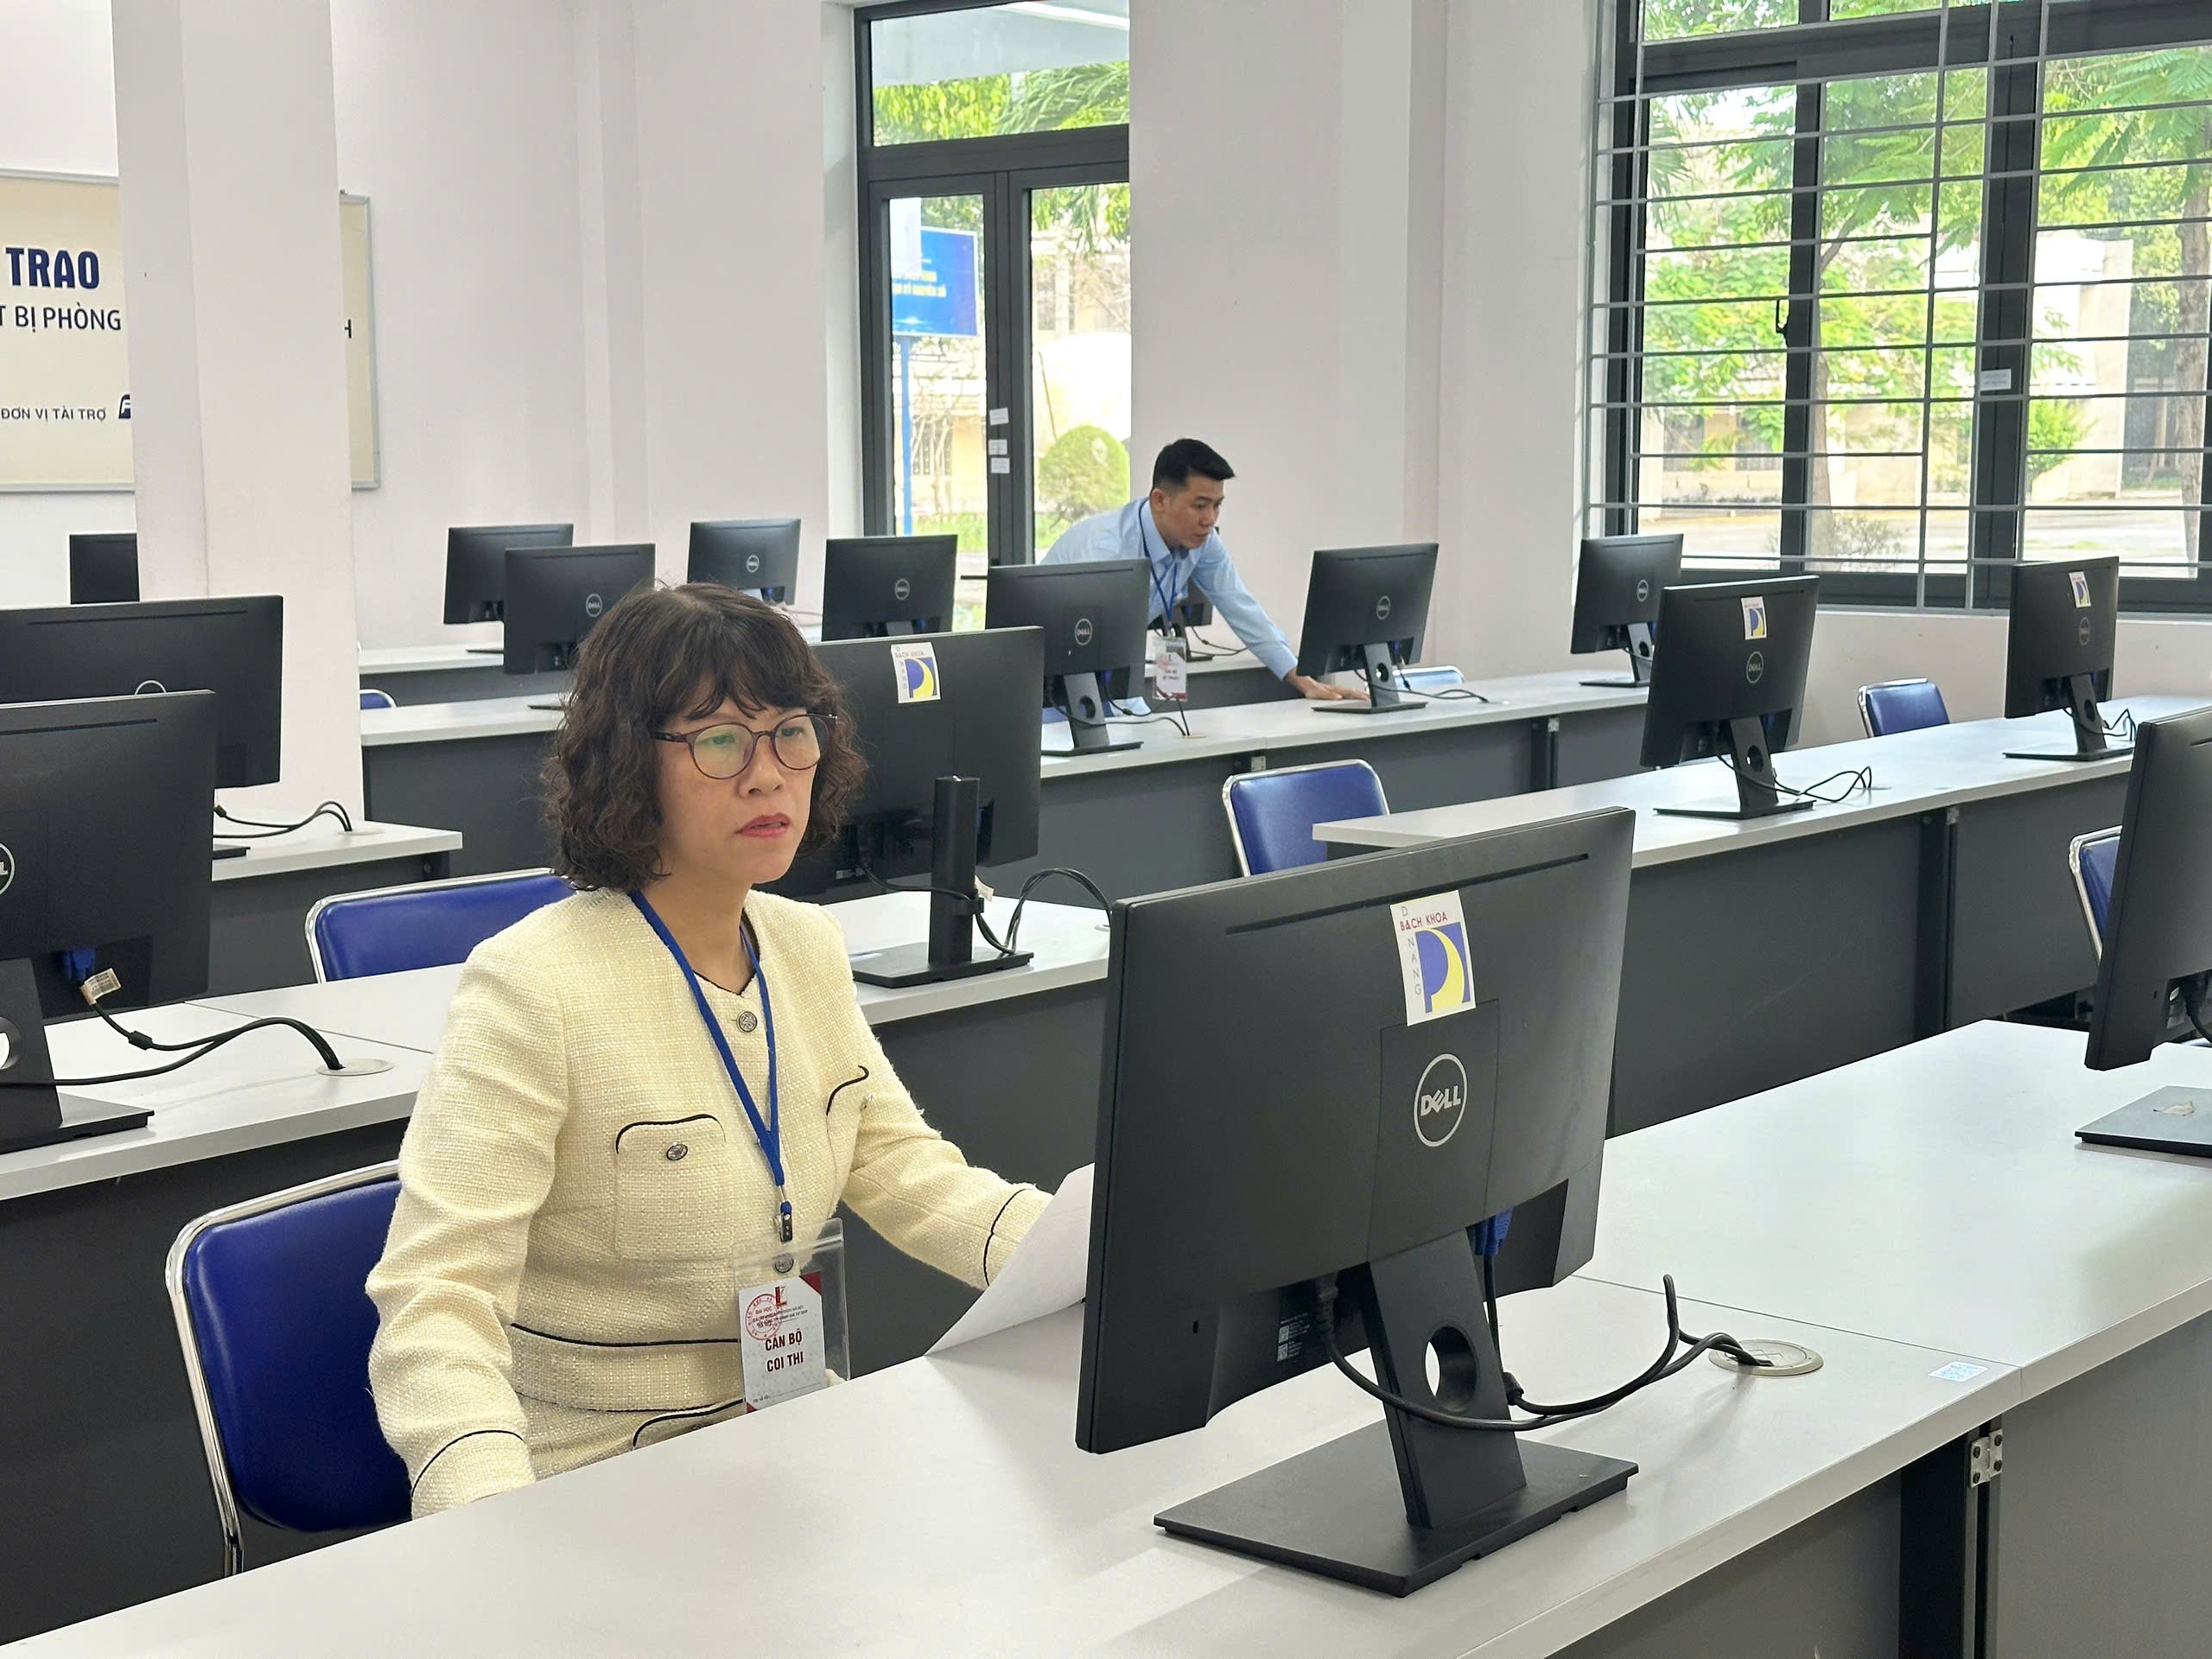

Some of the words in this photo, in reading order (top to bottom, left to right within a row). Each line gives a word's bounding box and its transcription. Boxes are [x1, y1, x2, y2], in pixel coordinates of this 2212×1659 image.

[5, 247, 100, 289] TRAO
[15, 305, 36, 334] BỊ
[42, 301, 122, 331] PHÒNG
[1, 406, 31, 420] ĐƠN
[35, 408, 48, 423] VỊ
[52, 404, 74, 420] TÀI
[78, 407, 107, 423] TRỢ
[1426, 911, 1449, 925] KHOA
[1421, 1084, 1462, 1116] DELL
[765, 1334, 785, 1351] CÁN
[788, 1327, 803, 1346] BỘ
[766, 1356, 785, 1372] COI
[787, 1351, 804, 1366] THI
